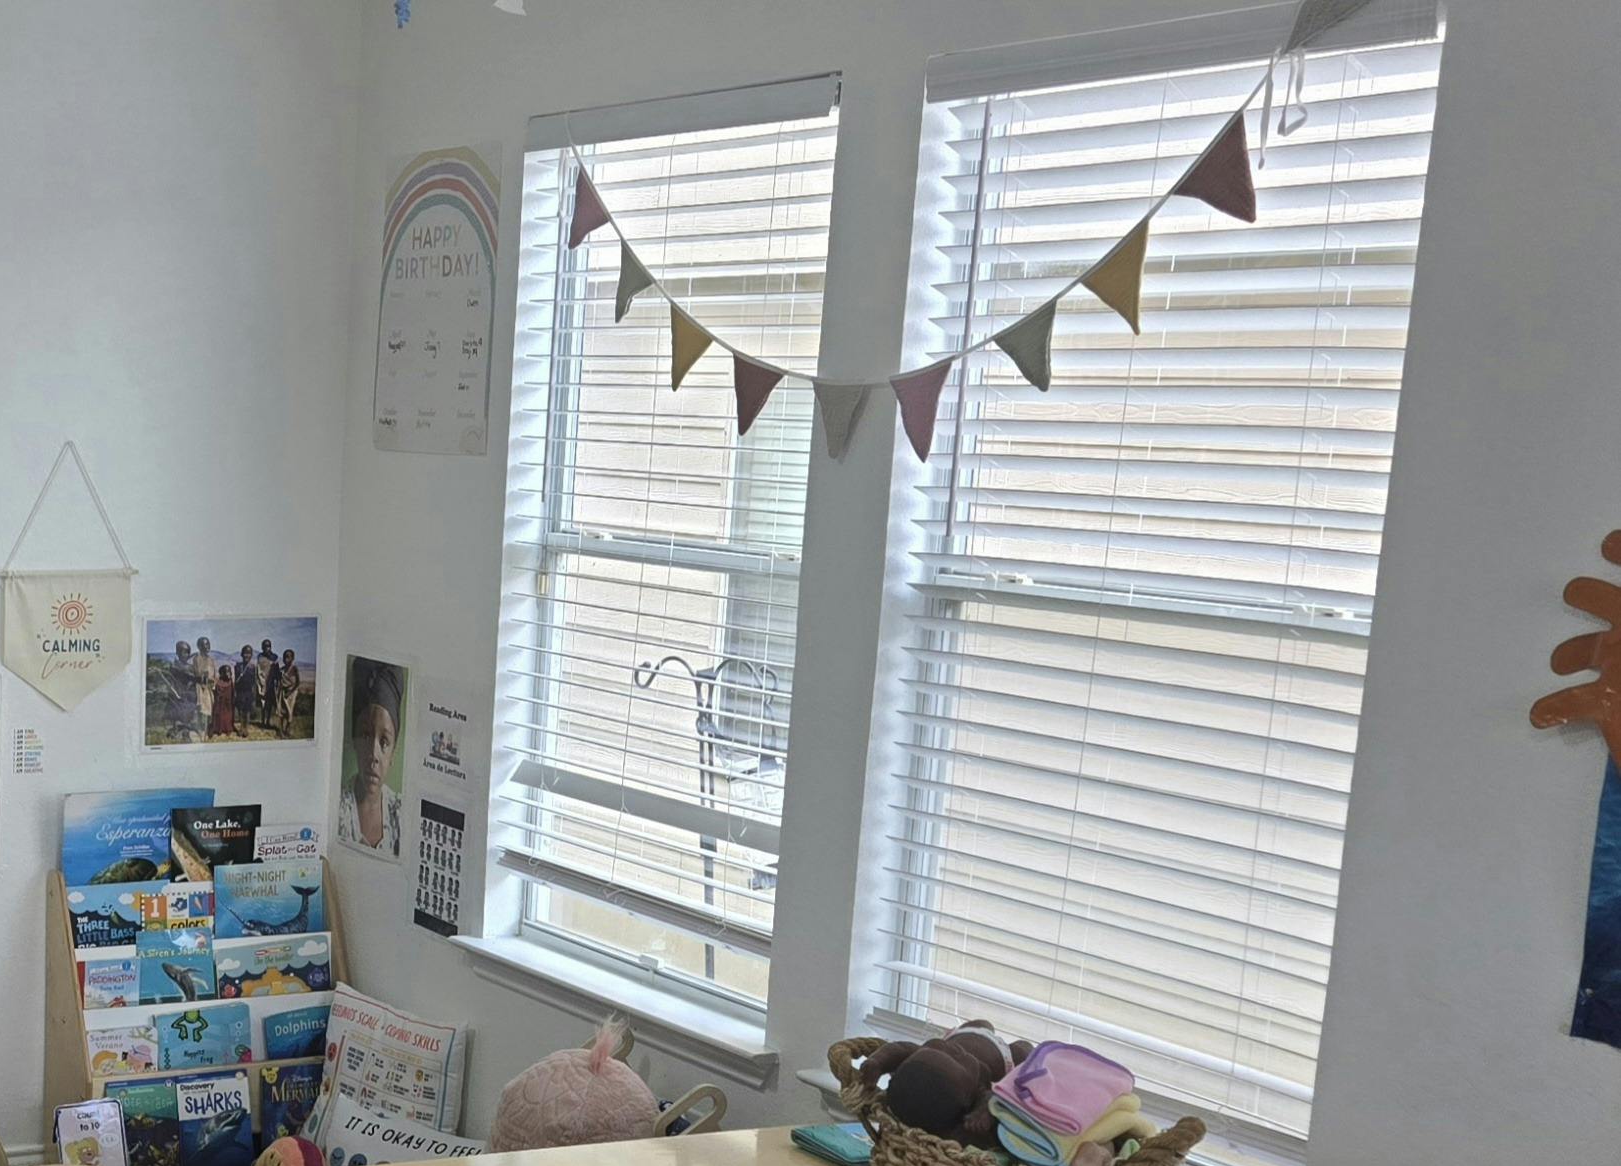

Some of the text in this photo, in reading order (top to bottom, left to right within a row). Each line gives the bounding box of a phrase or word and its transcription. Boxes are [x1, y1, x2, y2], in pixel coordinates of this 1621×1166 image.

[412, 224, 462, 250] HAPPY
[395, 252, 479, 280] BIRTHDAY!
[42, 638, 100, 653] CALMING
[194, 821, 213, 830] One
[201, 829, 249, 839] One Home
[257, 845, 287, 857] Splat
[296, 843, 316, 854] Cat
[150, 898, 159, 918] 1
[76, 916, 89, 924] THE
[170, 918, 206, 930] colors
[76, 920, 110, 935] THREE
[76, 930, 109, 944] LITTLE
[110, 927, 136, 939] BASS
[139, 950, 146, 958] A
[275, 1019, 326, 1036] Dolphins
[89, 1034, 122, 1042] Summer
[385, 1024, 411, 1043] COPING
[413, 1030, 442, 1052] SKILLS
[96, 1042, 124, 1050] Verano
[180, 1082, 214, 1091] Discovery
[185, 1090, 243, 1115] SHARKS
[91, 1121, 100, 1130] 10
[345, 1116, 361, 1130] IT
[361, 1122, 380, 1137] IS
[382, 1128, 424, 1150] OKAY
[426, 1139, 448, 1153] TO
